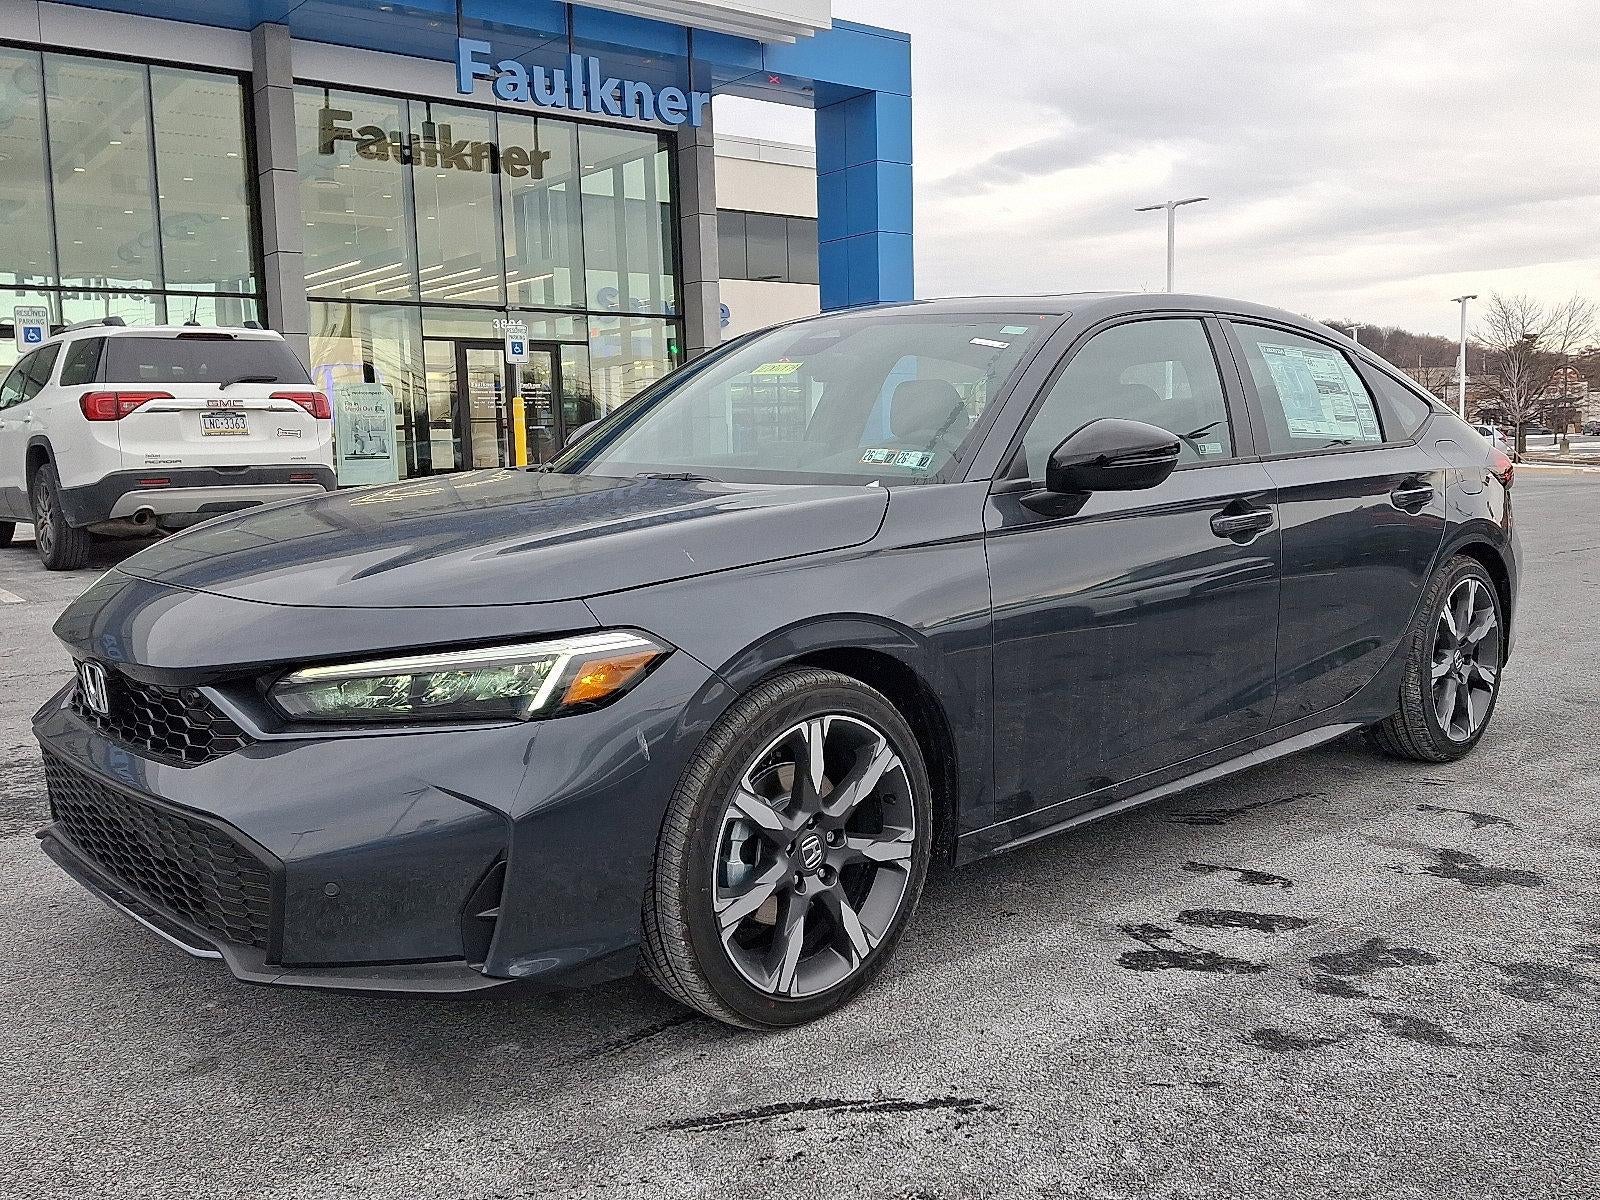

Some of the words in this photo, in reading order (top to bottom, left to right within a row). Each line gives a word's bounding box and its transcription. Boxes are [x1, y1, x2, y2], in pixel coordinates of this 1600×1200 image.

[456, 37, 711, 128] Faulkner
[318, 108, 551, 179] Faulkner
[16, 309, 46, 318] RESERVED
[18, 318, 45, 326] PARKING
[206, 399, 244, 408] GMC
